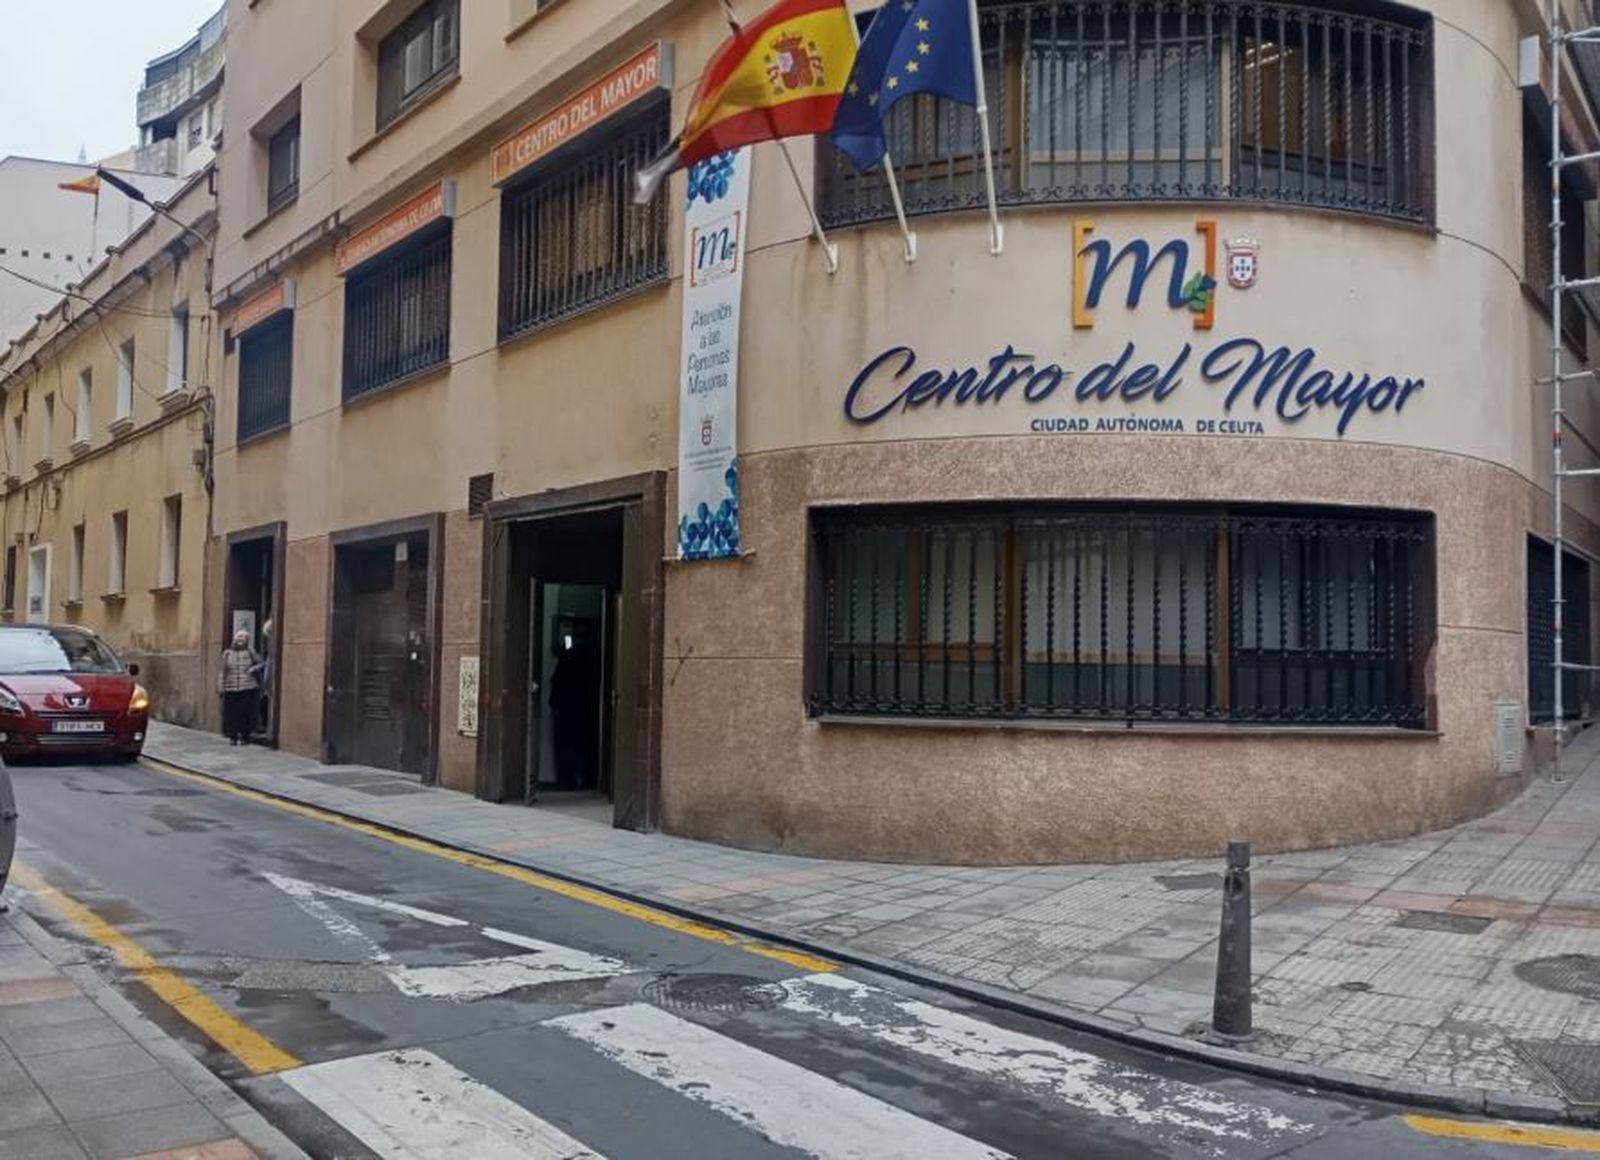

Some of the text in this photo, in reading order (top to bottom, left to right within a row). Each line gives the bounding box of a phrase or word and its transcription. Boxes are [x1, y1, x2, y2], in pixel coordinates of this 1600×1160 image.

[516, 57, 657, 163] CENTRO DEL MAYOR
[844, 337, 1424, 436] Centro del Mayor
[1031, 413, 1264, 433] CIUDAD AUTÓNOMA DE CEUTA
